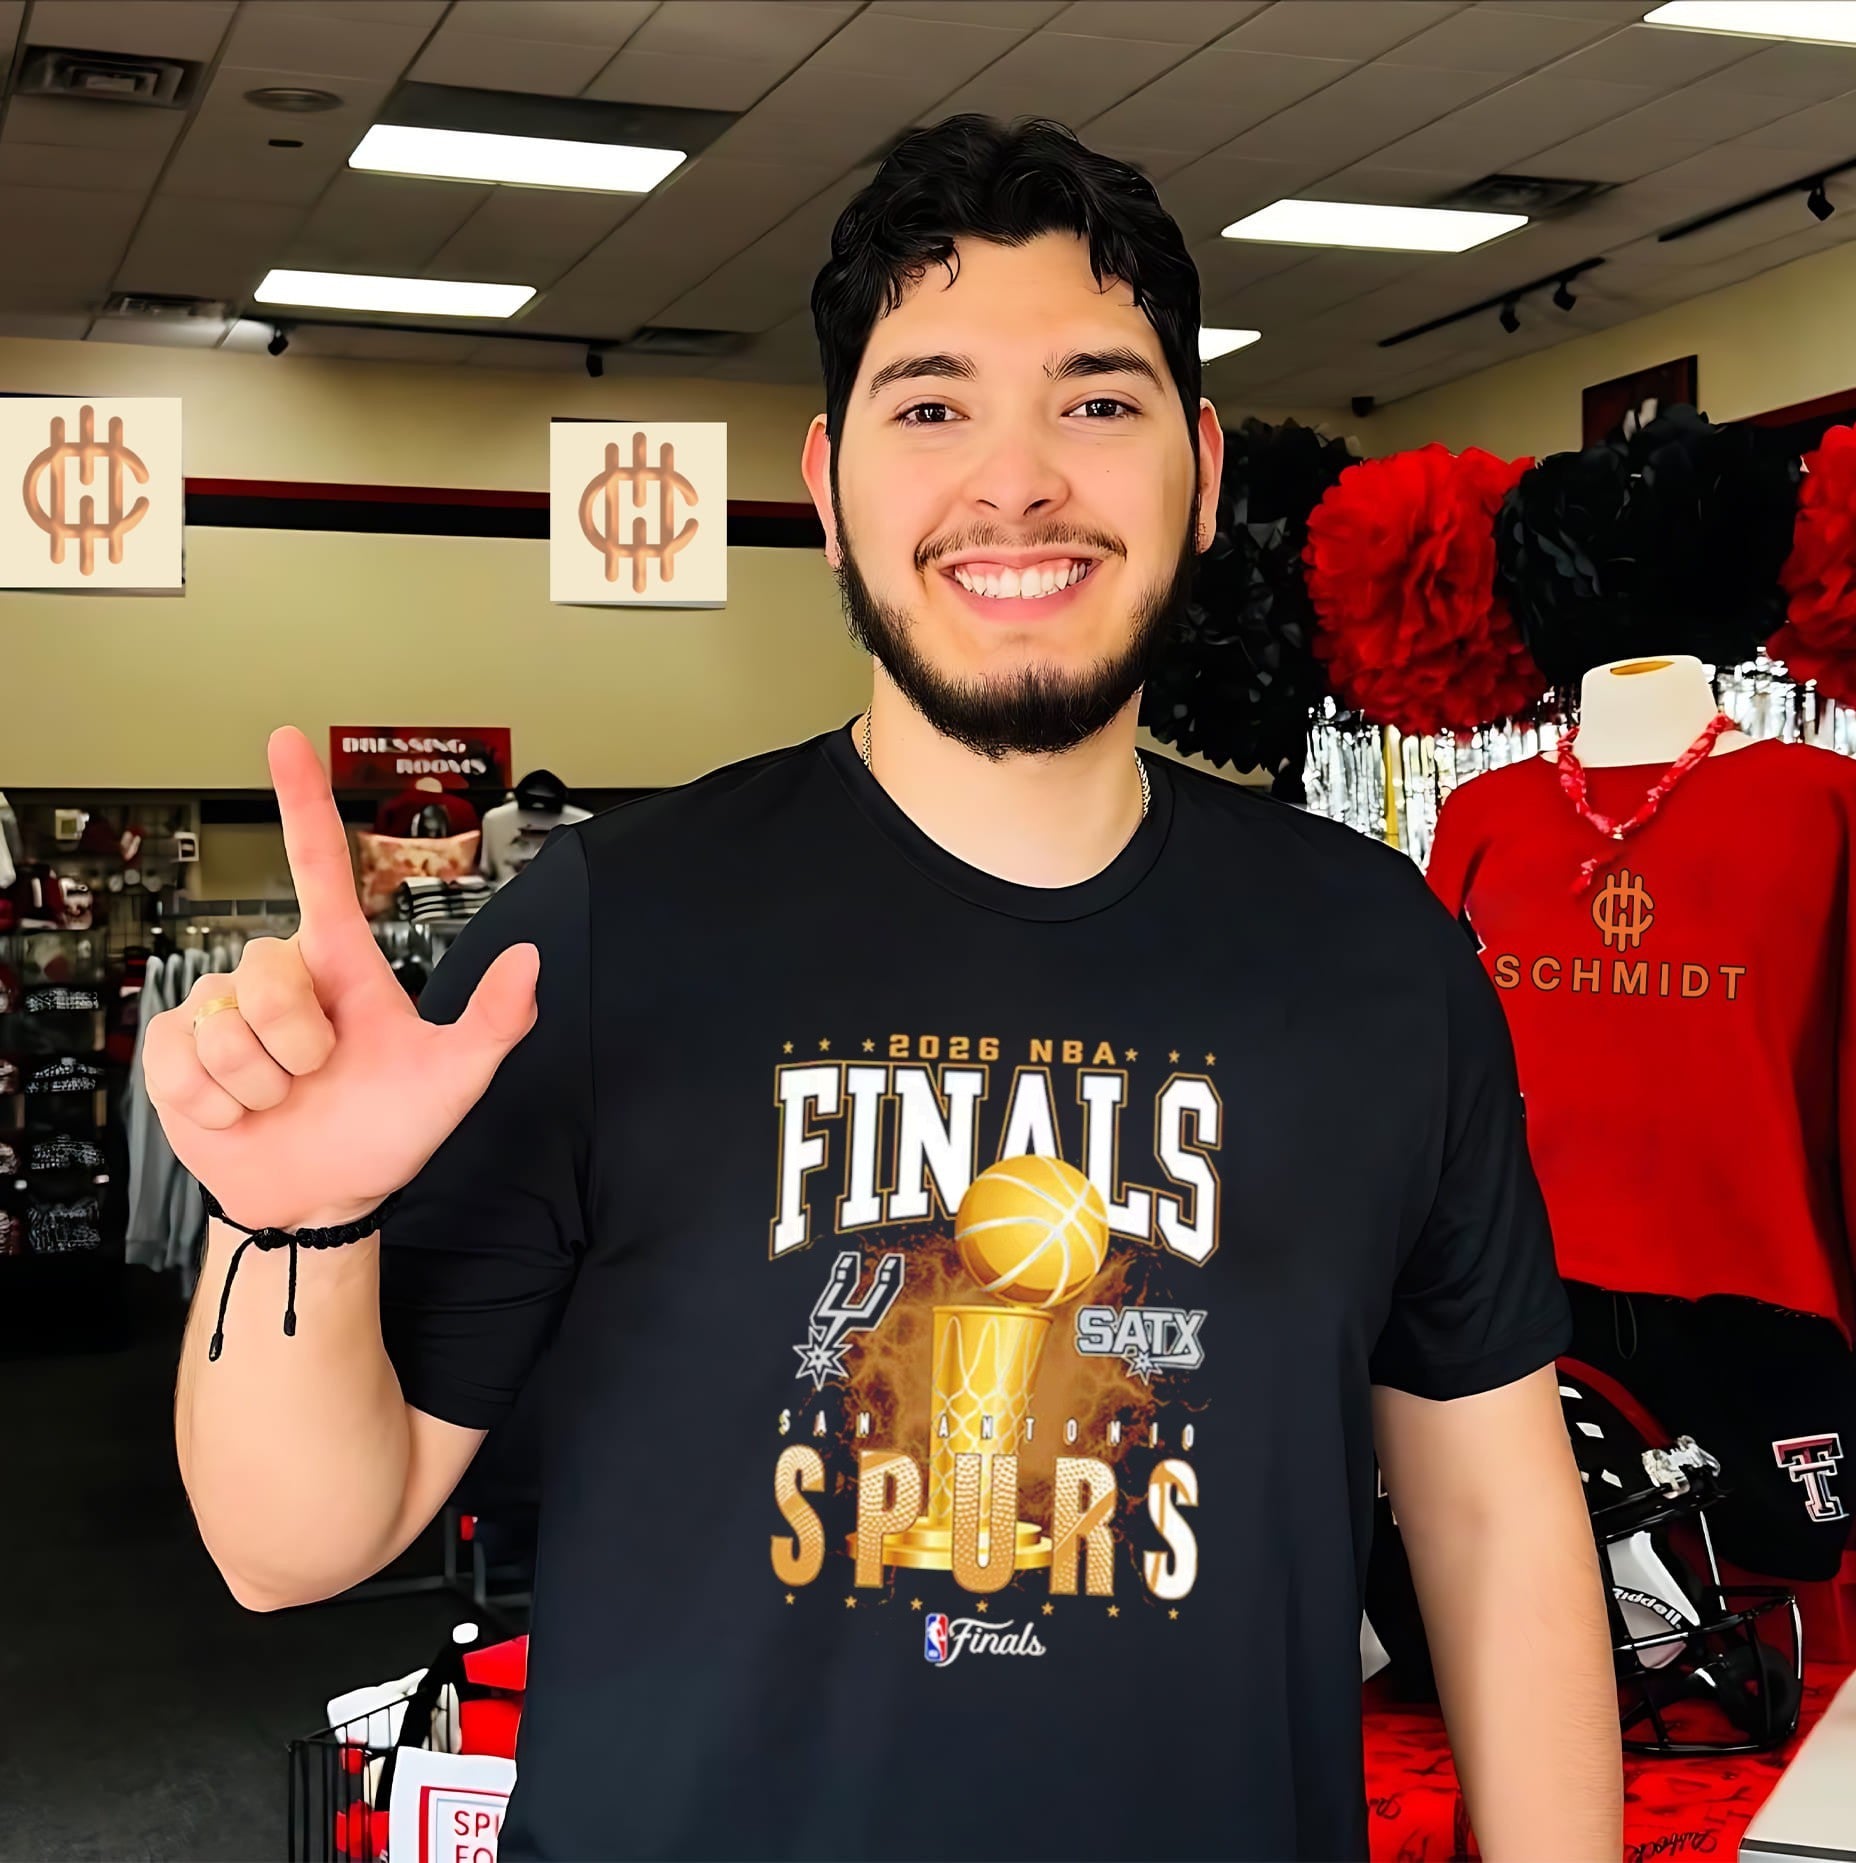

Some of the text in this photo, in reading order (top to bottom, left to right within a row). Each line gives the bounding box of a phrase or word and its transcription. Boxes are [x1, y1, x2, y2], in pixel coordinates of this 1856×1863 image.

[396, 758, 487, 775] ROOMS
[1494, 954, 1746, 1000] SCHMIDT
[889, 1034, 1116, 1066] 2026 NBA
[769, 1060, 1223, 1267] FINALS
[1075, 1306, 1208, 1370] SATX
[778, 1408, 1195, 1451] SAN ANTONIO
[770, 1445, 1200, 1600] SPURS
[935, 1617, 1047, 1667] Finals
